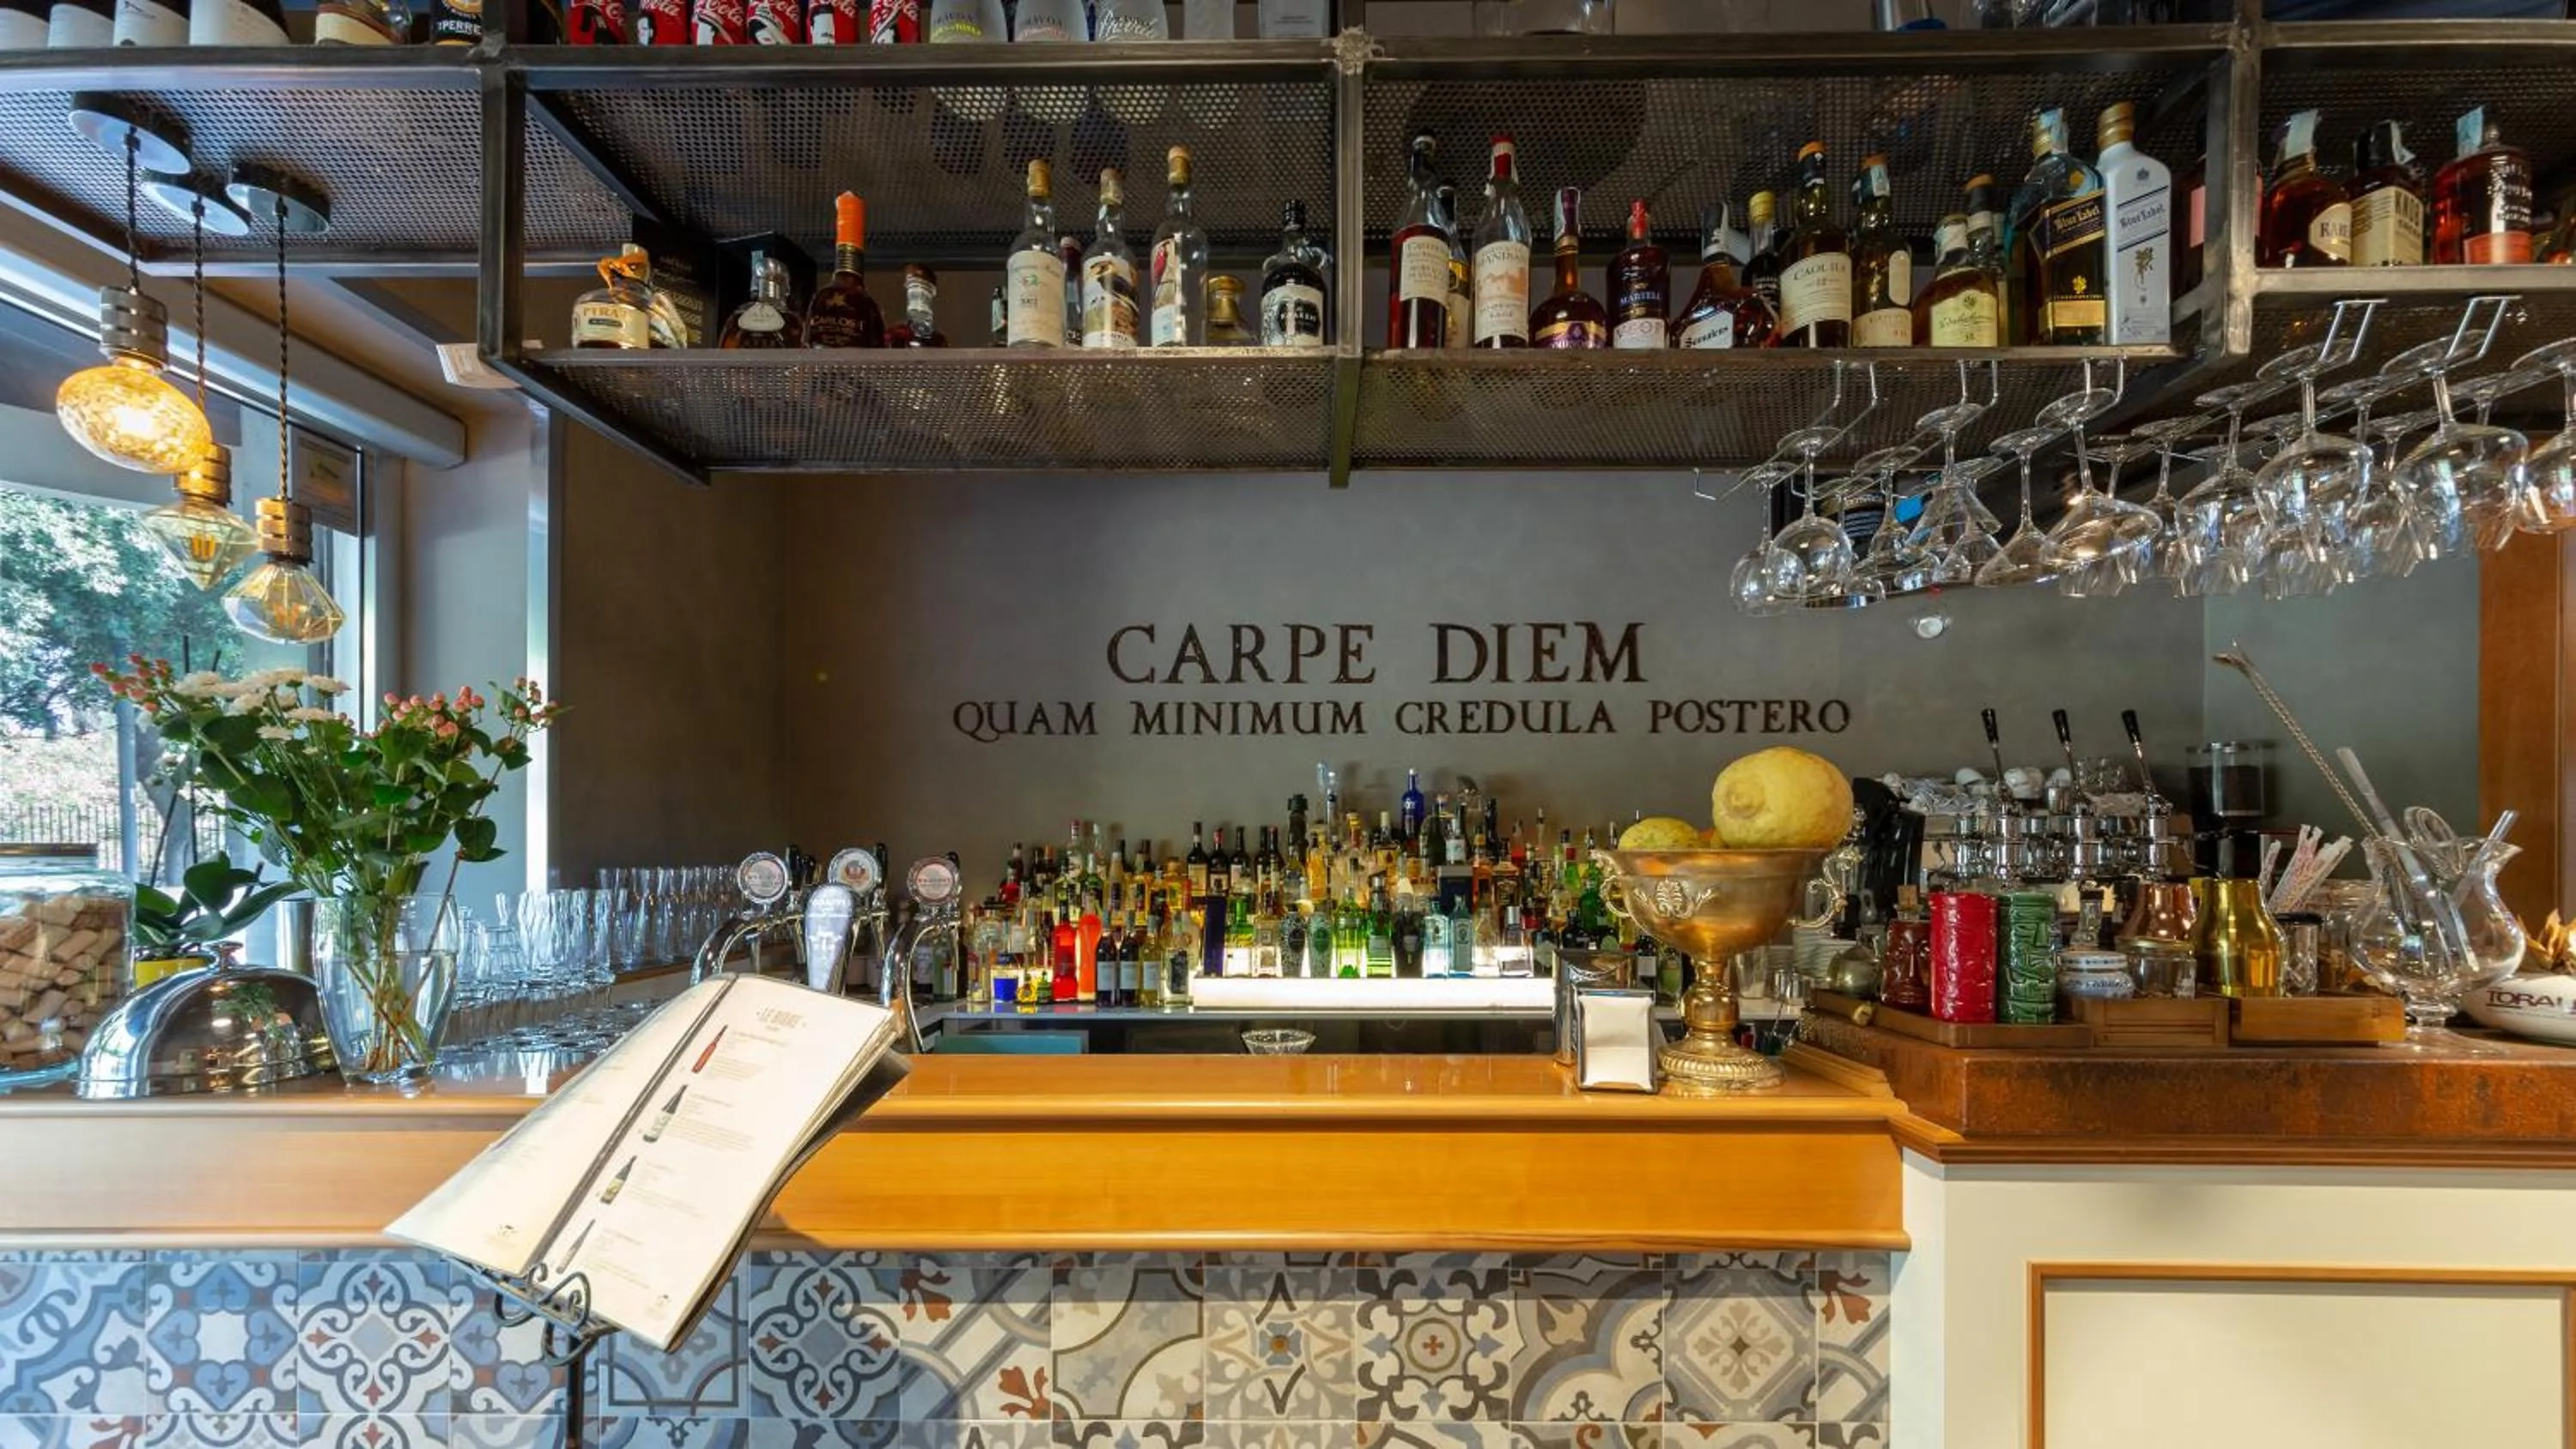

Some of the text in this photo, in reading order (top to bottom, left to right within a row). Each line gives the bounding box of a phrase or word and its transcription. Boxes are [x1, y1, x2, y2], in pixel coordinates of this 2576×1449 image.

[2141, 203, 2166, 221] Label
[1107, 621, 1649, 684] CARPE DIEM
[952, 698, 1851, 743] QUAM MINIMUM CREDULA POSTERO
